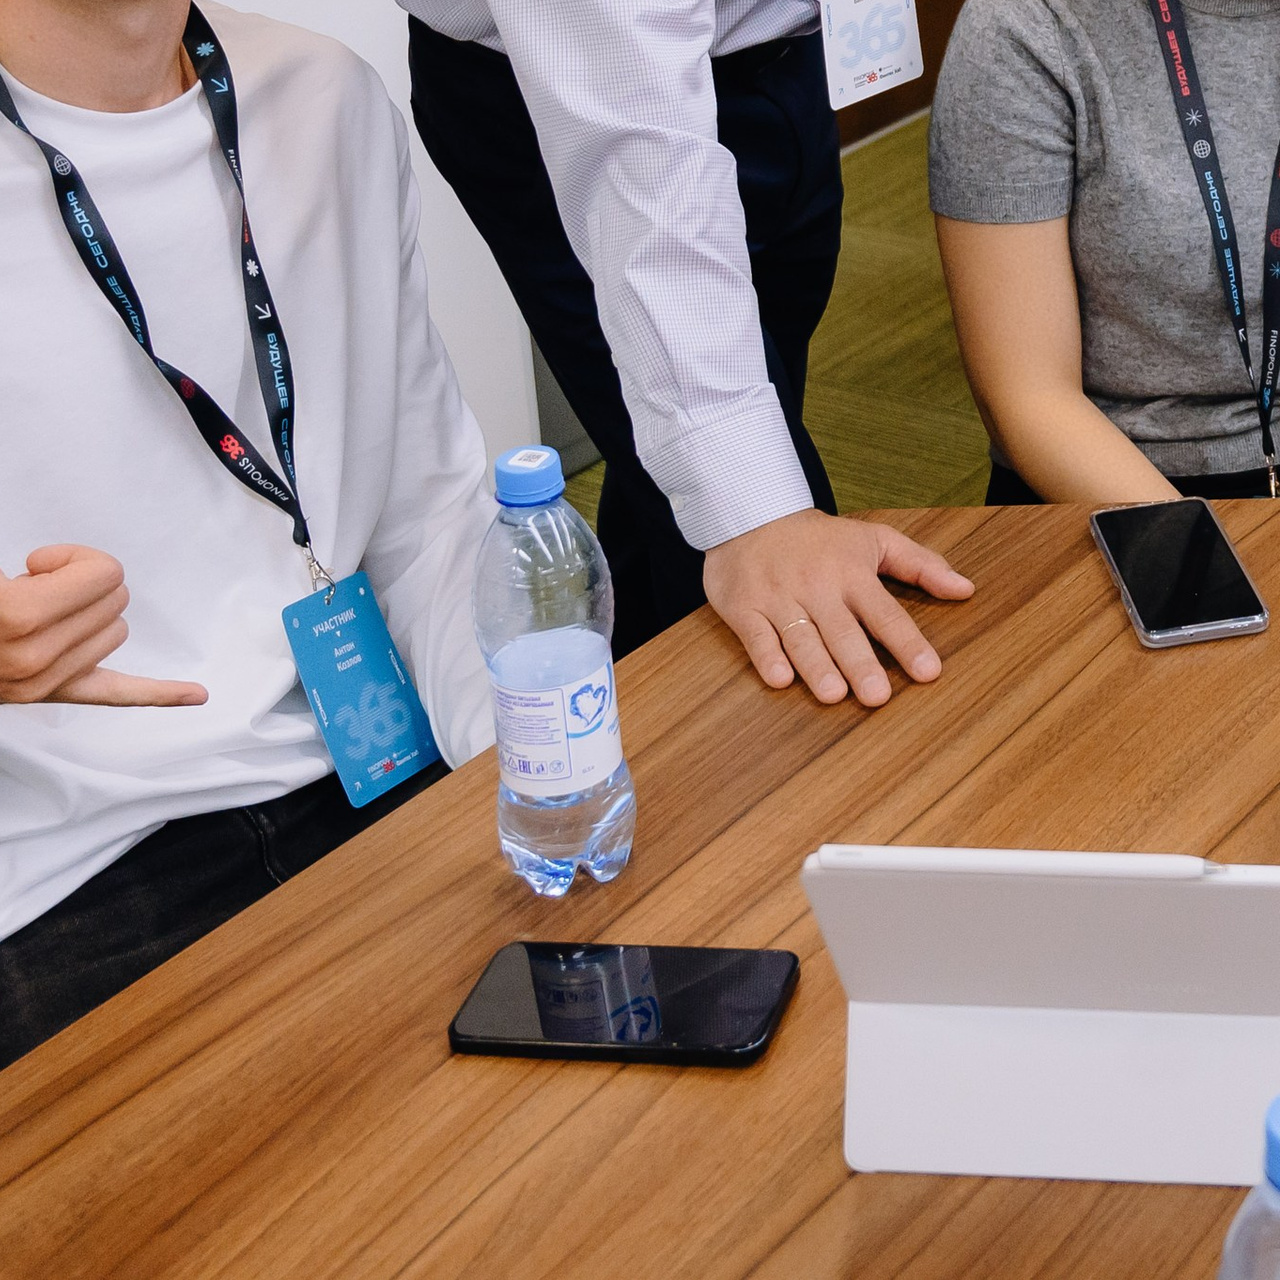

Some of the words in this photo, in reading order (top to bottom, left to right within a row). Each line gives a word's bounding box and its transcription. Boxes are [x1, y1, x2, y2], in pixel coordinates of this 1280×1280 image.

[838, 2, 907, 69] 365
[1166, 29, 1191, 97] БУДУЩЕЕ
[66, 190, 109, 269] СЕГОДНЯ
[1204, 171, 1229, 241] СЕГОДНЯ
[105, 275, 145, 345] БУДУЩЕЕ
[1223, 247, 1241, 317] БУДУЩЕЕ
[266, 332, 290, 410] БУДУЩЕЕ
[1265, 328, 1278, 387] FINOPOLIS
[219, 433, 246, 461] 365
[239, 456, 290, 502] FINOPOLIS
[312, 607, 356, 637] УЧАСТНИК
[334, 641, 356, 658] Антон
[336, 653, 362, 672] Козлов
[335, 680, 412, 761] 365
